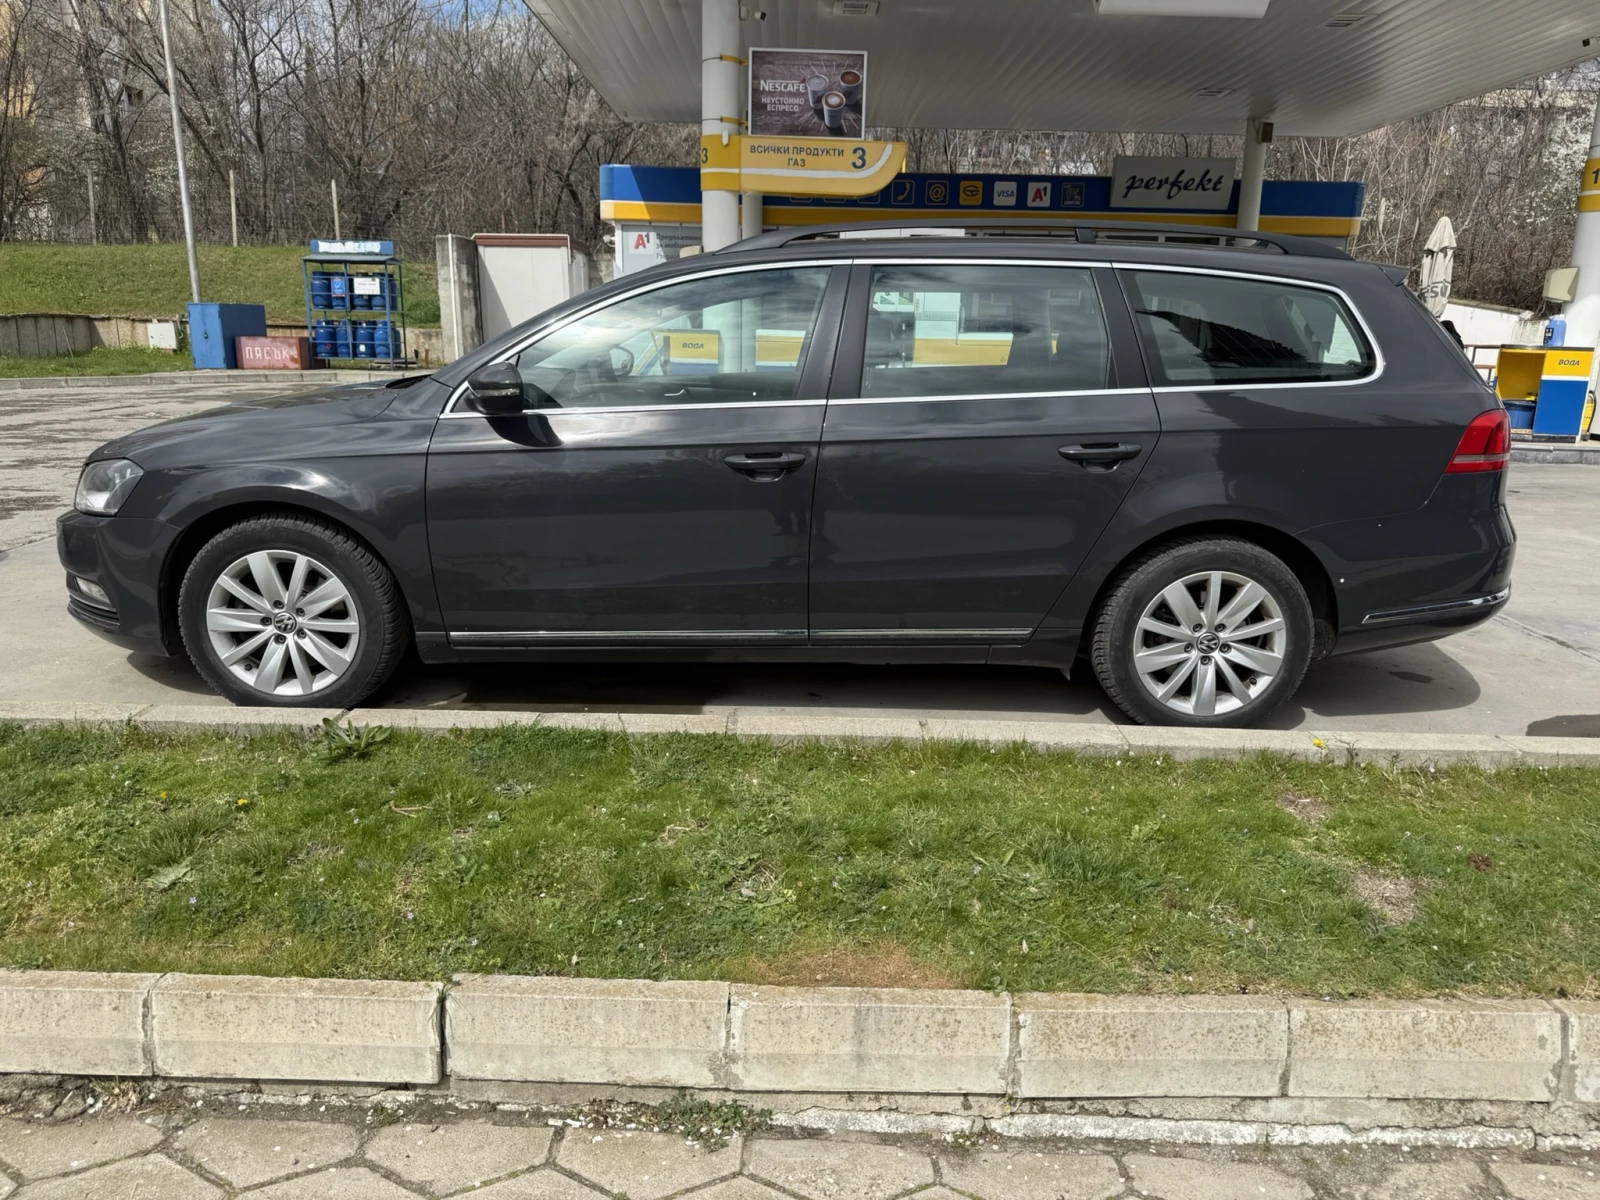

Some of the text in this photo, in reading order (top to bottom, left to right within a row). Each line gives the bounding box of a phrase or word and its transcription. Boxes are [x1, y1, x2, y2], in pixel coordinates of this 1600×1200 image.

[762, 97, 805, 105] НЕУСТОИМО
[767, 104, 799, 112] ЕСПРЕСО
[750, 145, 844, 157] ВСИЧКИ ПРОДУКТИ
[788, 158, 806, 167] ГАЗ
[852, 147, 867, 169] 3
[1122, 169, 1224, 200] perfekt
[996, 189, 1015, 198] VISA
[1032, 186, 1048, 202] A1
[634, 232, 650, 249] A1
[245, 346, 289, 360] ПЯСЪК
